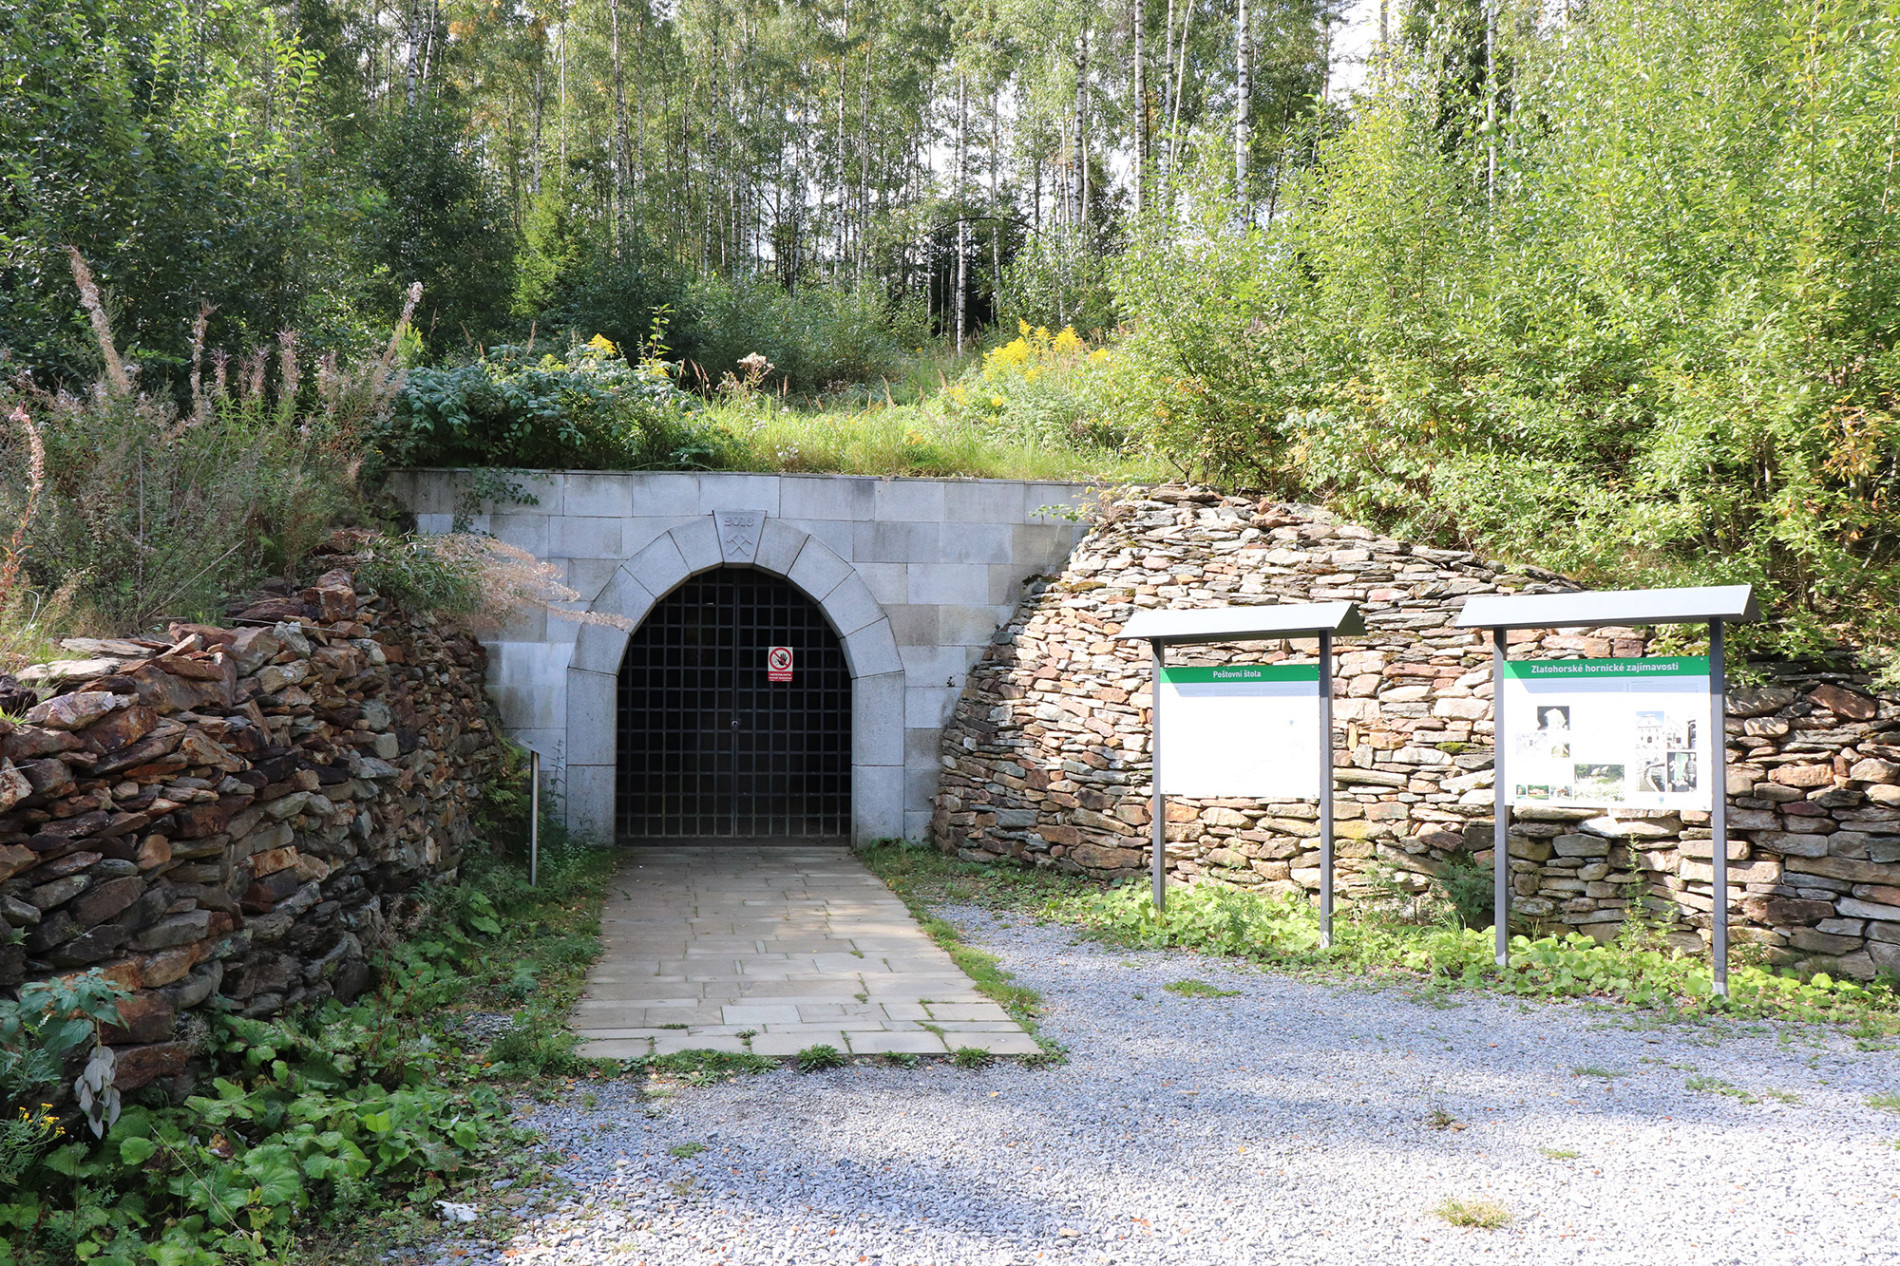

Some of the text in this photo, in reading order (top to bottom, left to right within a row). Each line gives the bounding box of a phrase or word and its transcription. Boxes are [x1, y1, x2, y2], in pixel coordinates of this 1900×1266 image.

[1531, 662, 1679, 674] Zlatohorské hornické zajímavosti
[1244, 670, 1262, 678] štola
